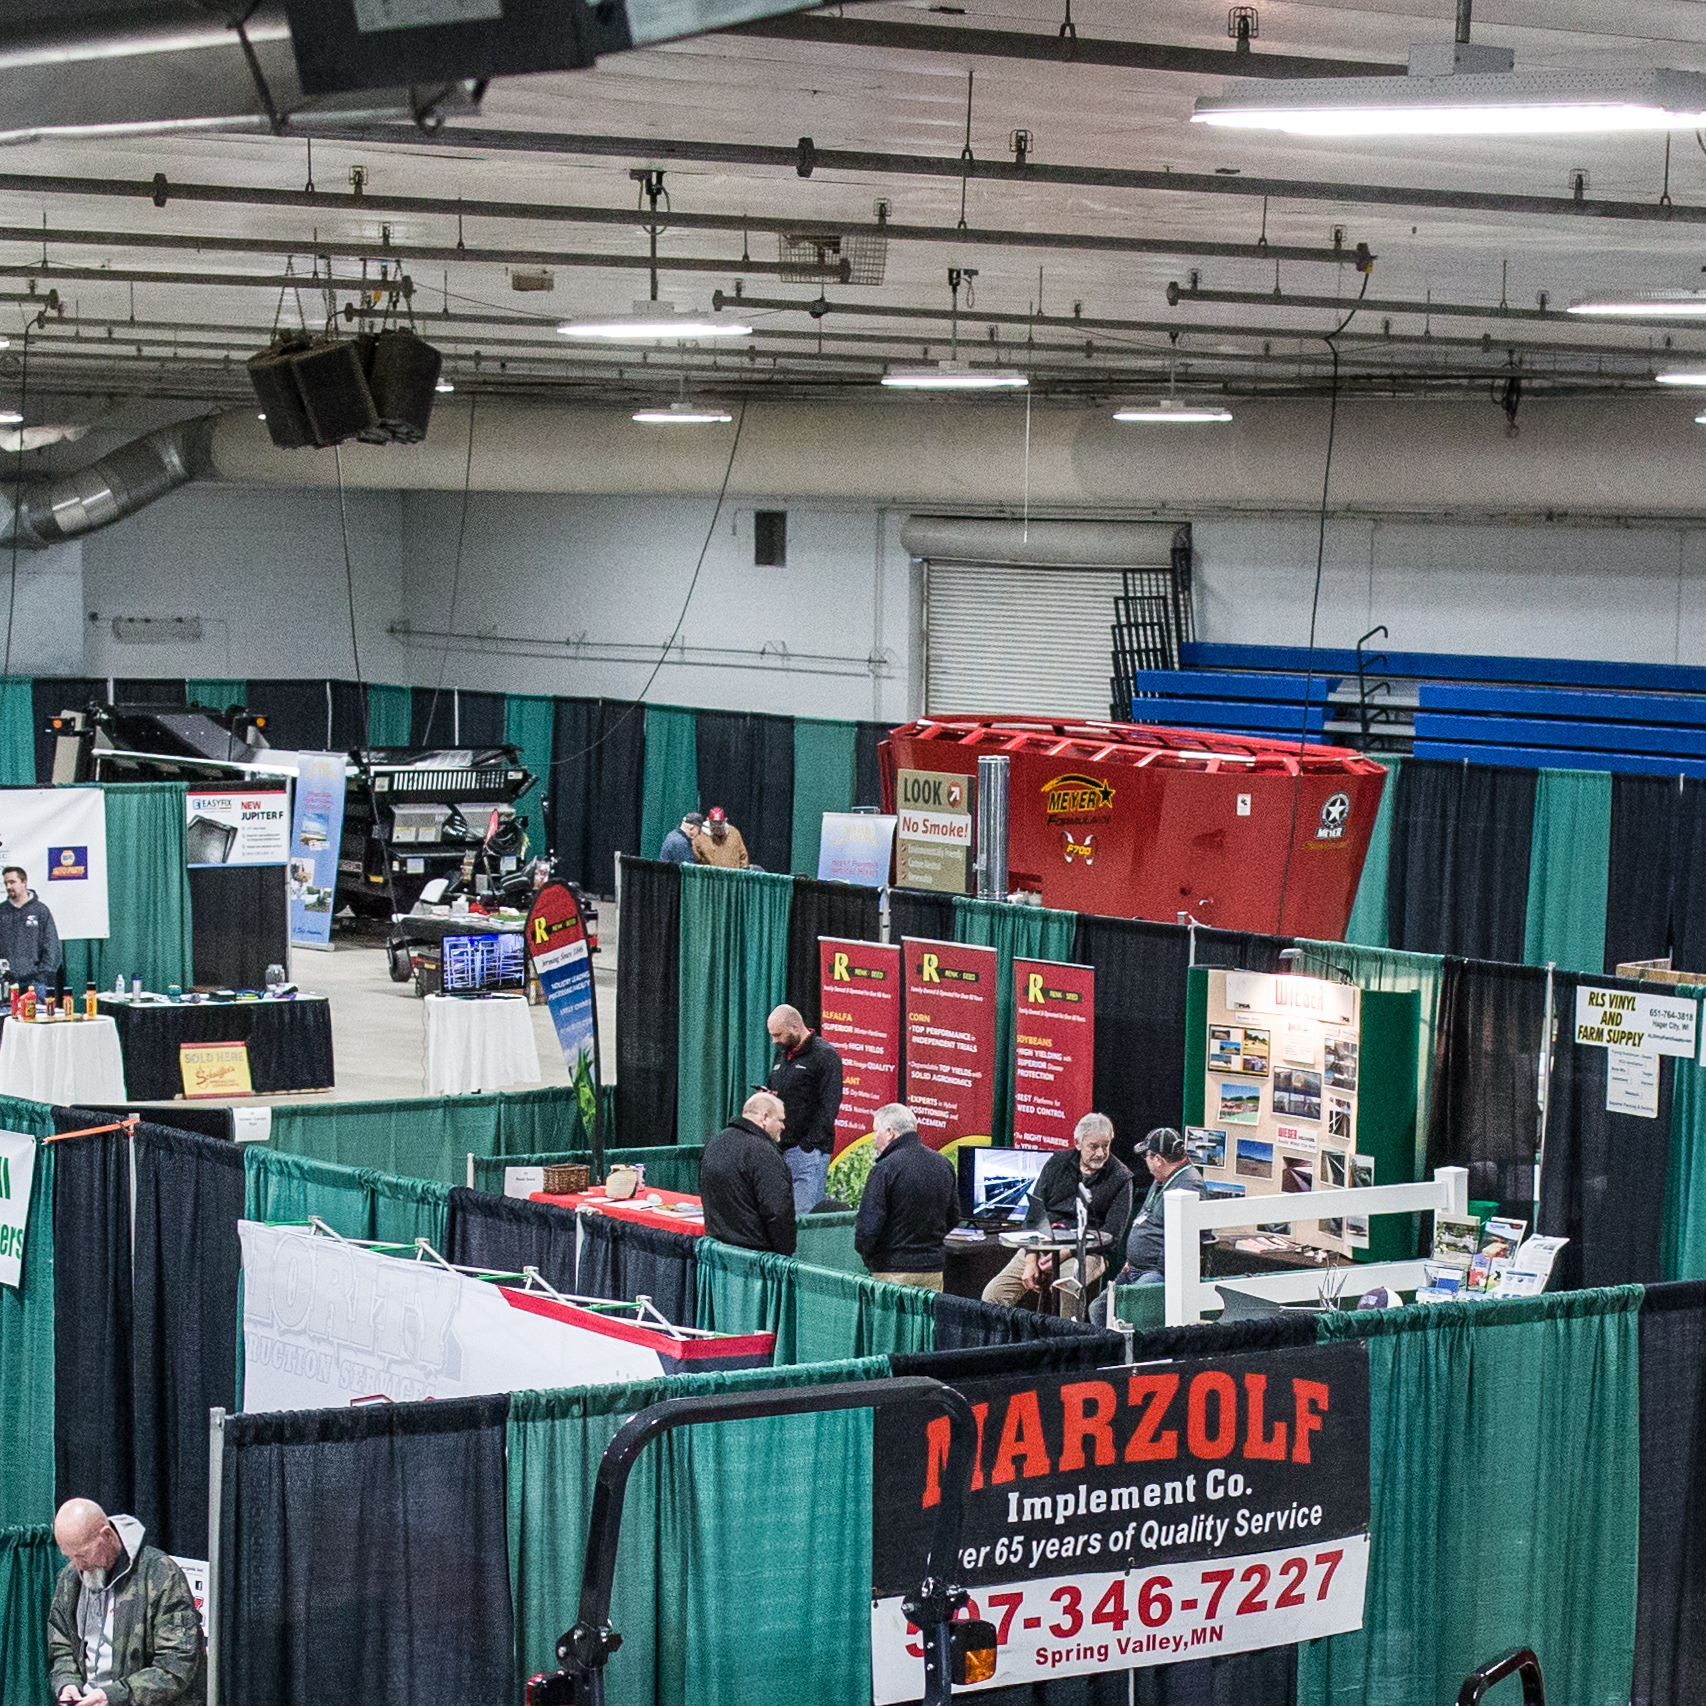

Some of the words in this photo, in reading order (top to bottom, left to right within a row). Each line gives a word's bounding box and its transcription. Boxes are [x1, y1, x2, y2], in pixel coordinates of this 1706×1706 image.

[903, 777, 943, 806] LOOK
[1048, 791, 1096, 812] MEYER
[202, 799, 232, 807] EASYFIX
[241, 801, 261, 810] NEW
[241, 812, 278, 821] JUPITER
[279, 812, 284, 820] F
[902, 817, 919, 834] No
[921, 818, 969, 838] Smoke!
[1028, 973, 1045, 1004] R
[1588, 991, 1605, 1007] RLS
[1608, 993, 1636, 1011] VINYL
[909, 1012, 930, 1023] CORN
[1600, 1010, 1622, 1026] AND
[1578, 1025, 1603, 1043] FARM
[1606, 1027, 1644, 1047] SUPPLY
[184, 1052, 213, 1064] SOLD
[216, 1051, 244, 1062] HERE
[1007, 1473, 1196, 1525] Implement
[1205, 1468, 1254, 1498] Co.
[994, 1536, 1024, 1567] 65
[1029, 1530, 1102, 1571] years
[1108, 1521, 1136, 1552] of
[1140, 1515, 1230, 1551] Quality
[1234, 1501, 1324, 1538] Service
[1035, 1643, 1111, 1669] Spring
[1116, 1625, 1225, 1660] Valley,MN
